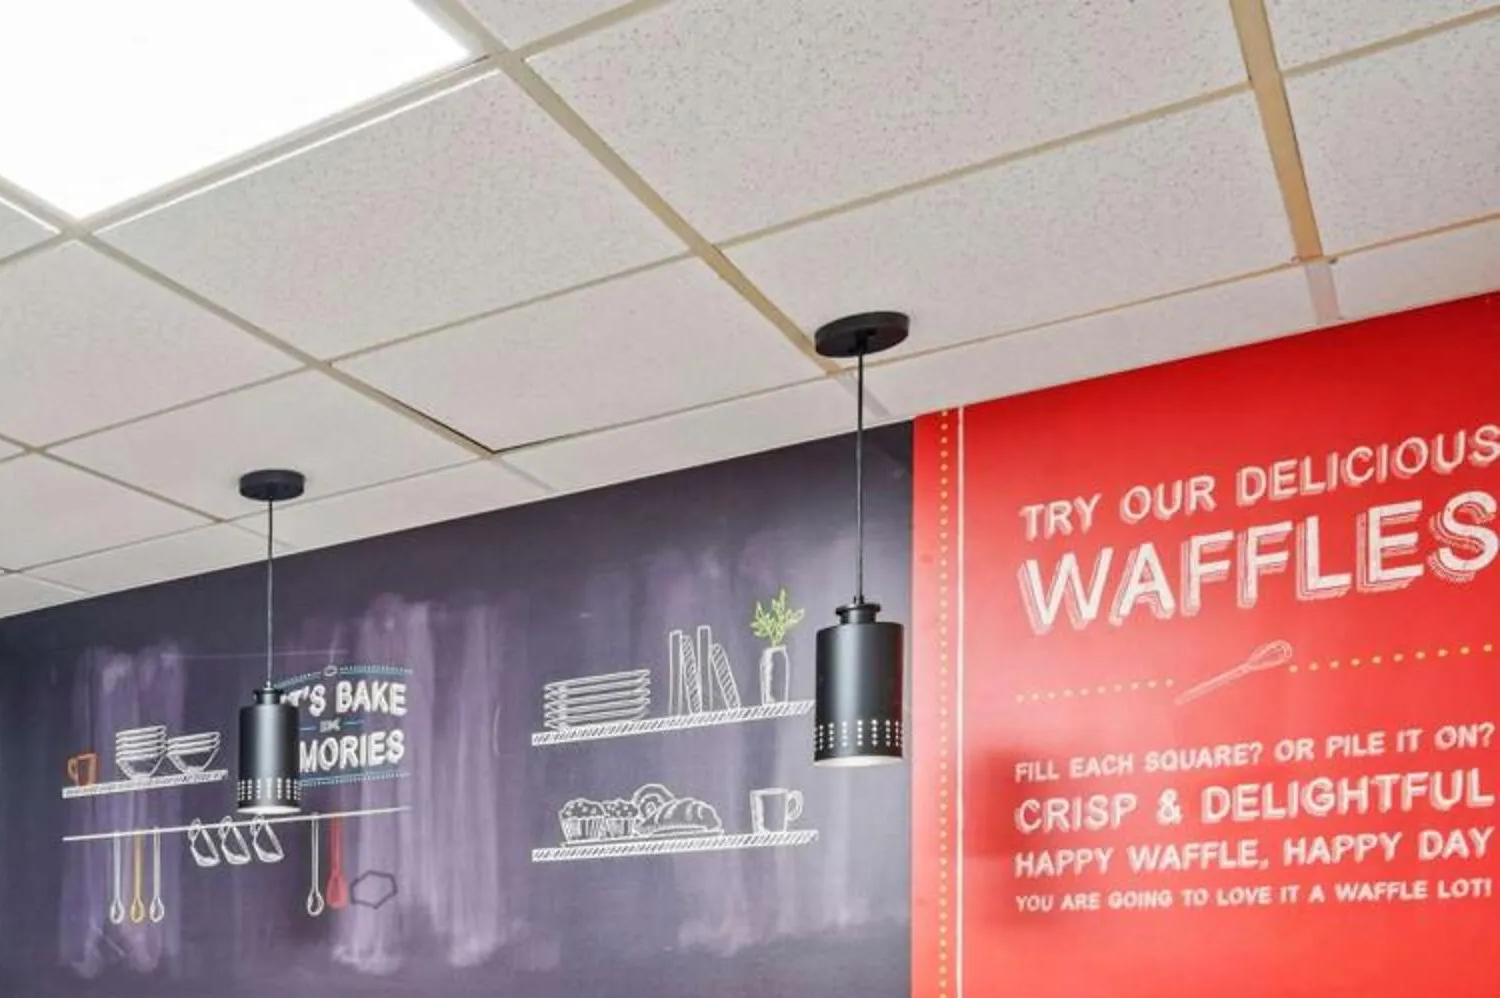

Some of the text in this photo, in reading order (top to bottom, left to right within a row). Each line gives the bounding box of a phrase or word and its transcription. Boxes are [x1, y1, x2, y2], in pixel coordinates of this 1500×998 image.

[1019, 424, 1500, 541] TRY OUR DELICIOUS
[1016, 491, 1499, 636] WAFFLES
[336, 680, 407, 716] BAKE
[299, 729, 405, 773] MORIES
[1015, 721, 1495, 783] FILL EACH SQUARE? OR PILE IT ON?
[1014, 768, 1495, 834] CRISP & DELIGHTFUL
[1015, 826, 1495, 878] HAPPY WAFFLE, HAPPY DAY
[1015, 877, 1493, 912] YOU ARE GOING TO LOVE IT A WAFFLE LOT!
